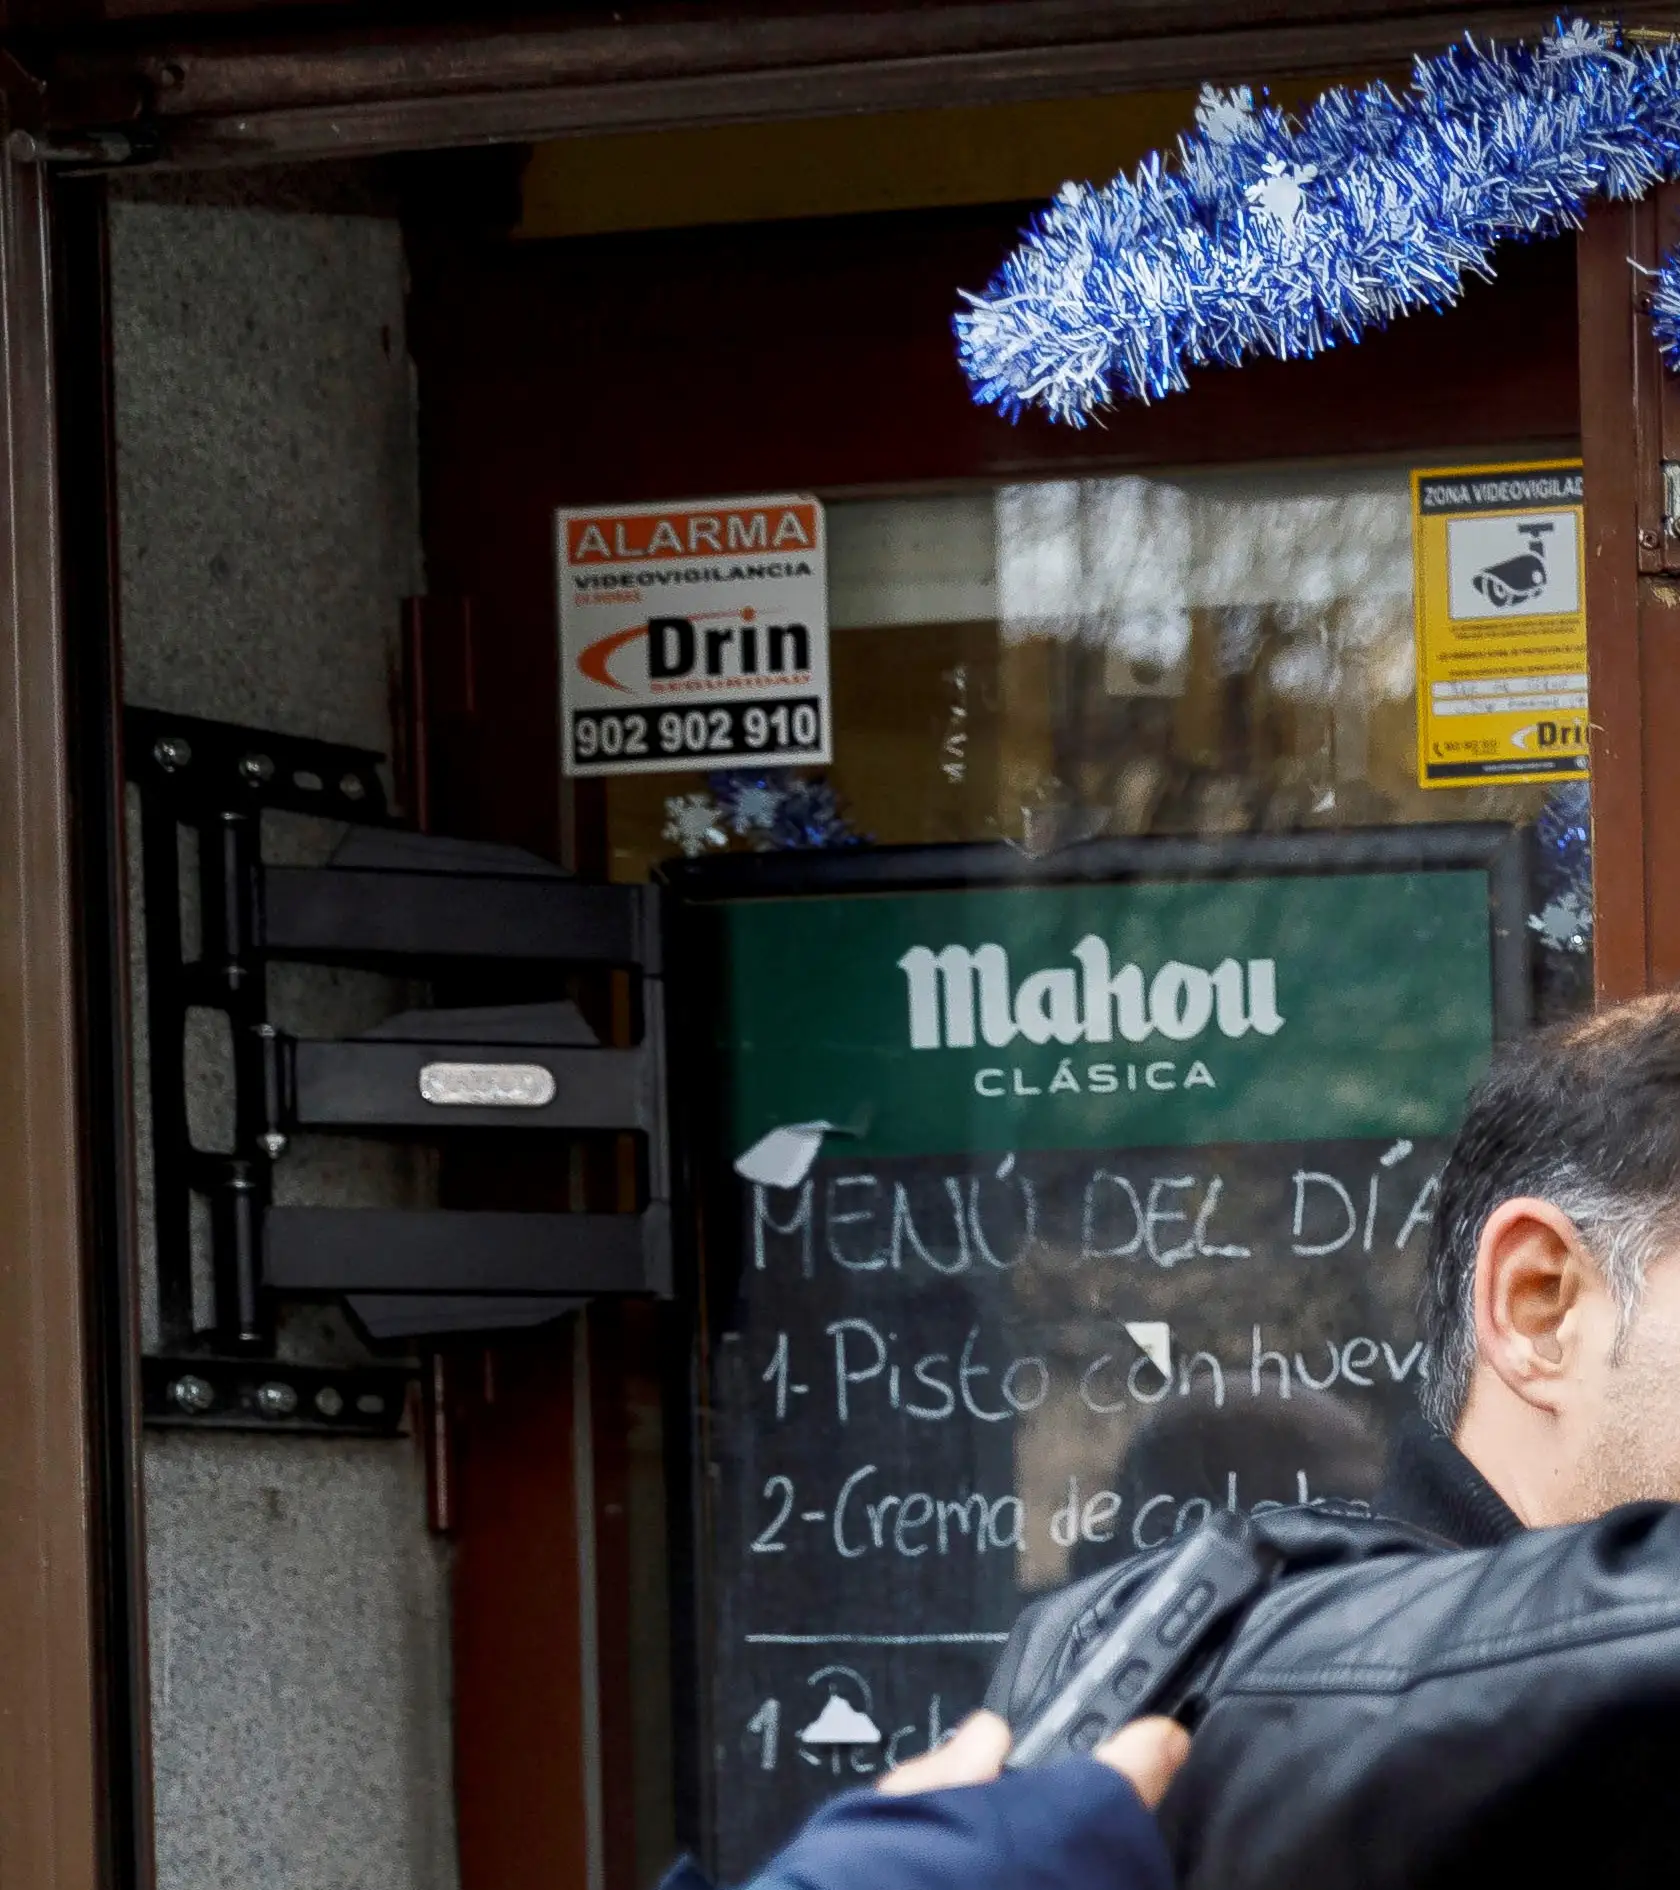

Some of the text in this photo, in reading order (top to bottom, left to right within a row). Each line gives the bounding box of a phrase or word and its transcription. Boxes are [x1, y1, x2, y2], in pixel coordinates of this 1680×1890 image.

[1472, 476, 1584, 503] VIDEOVIGILAD
[574, 511, 810, 560] ALARMA
[574, 562, 812, 590] VIDEOVIGILANCIA
[650, 606, 811, 680] Drin
[575, 705, 818, 756] 902 902 910
[1537, 717, 1586, 747] Dri
[898, 933, 1286, 1049] Mahou
[974, 1058, 1216, 1096] CLÁSICA
[753, 1153, 1037, 1278] MENÚ
[1081, 1170, 1250, 1266] DEL
[1048, 1474, 1120, 1549] de
